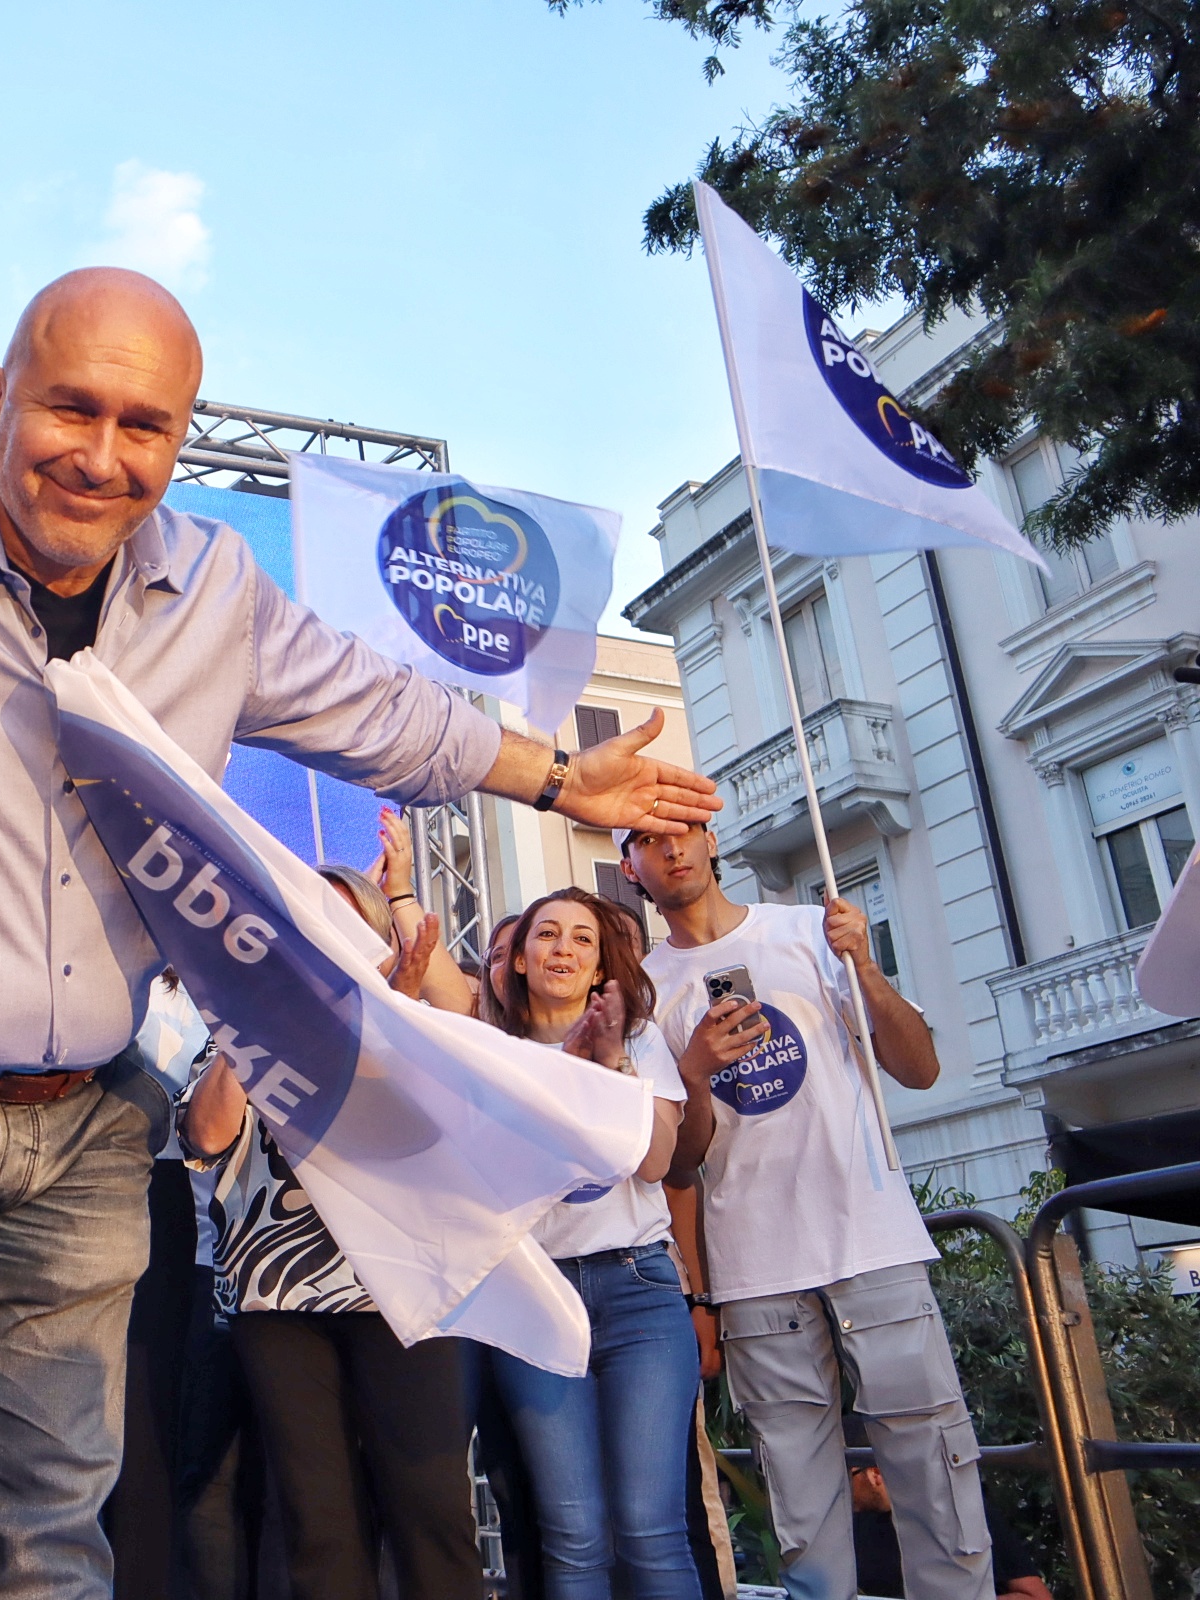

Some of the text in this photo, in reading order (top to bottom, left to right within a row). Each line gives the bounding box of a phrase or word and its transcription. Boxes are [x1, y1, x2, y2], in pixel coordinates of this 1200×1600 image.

[389, 546, 546, 607] ALTERNATIVA
[389, 565, 544, 631] POPOLARE
[463, 622, 510, 652] ppe
[1109, 778, 1143, 797] DEMETRIO
[1144, 765, 1172, 782] ROMEO
[1122, 785, 1148, 800] OCULISTA
[710, 1046, 802, 1088] POPOLARE
[751, 1078, 784, 1100] ppe
